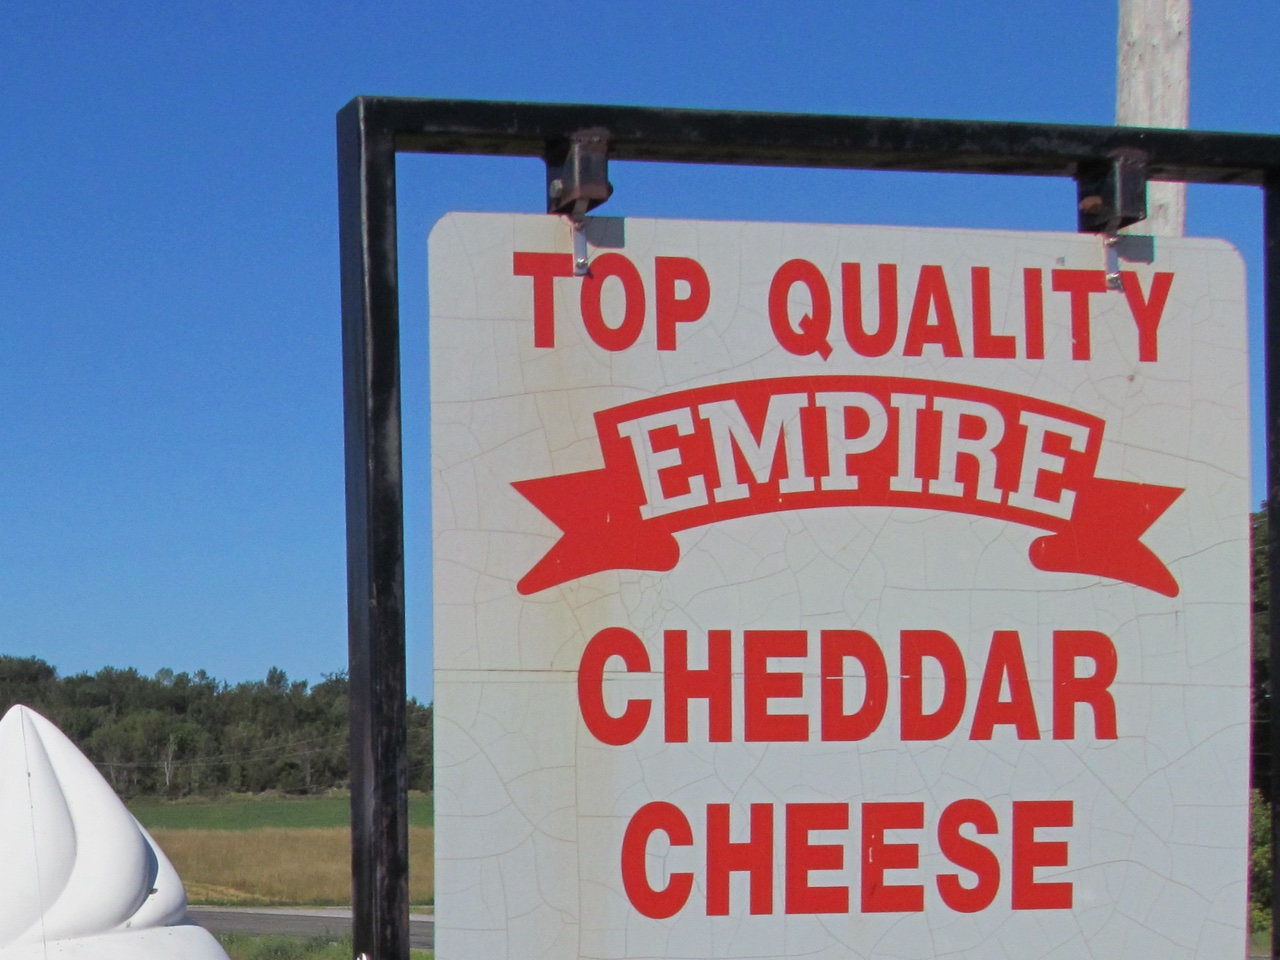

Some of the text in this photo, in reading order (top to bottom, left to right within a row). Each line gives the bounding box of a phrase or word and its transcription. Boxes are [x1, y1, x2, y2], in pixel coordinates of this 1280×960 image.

[514, 252, 1173, 361] TOP QUALITY
[617, 391, 1091, 520] EMPIRE
[578, 627, 1117, 745] CHEDDAR
[622, 799, 1073, 918] CHEESE
